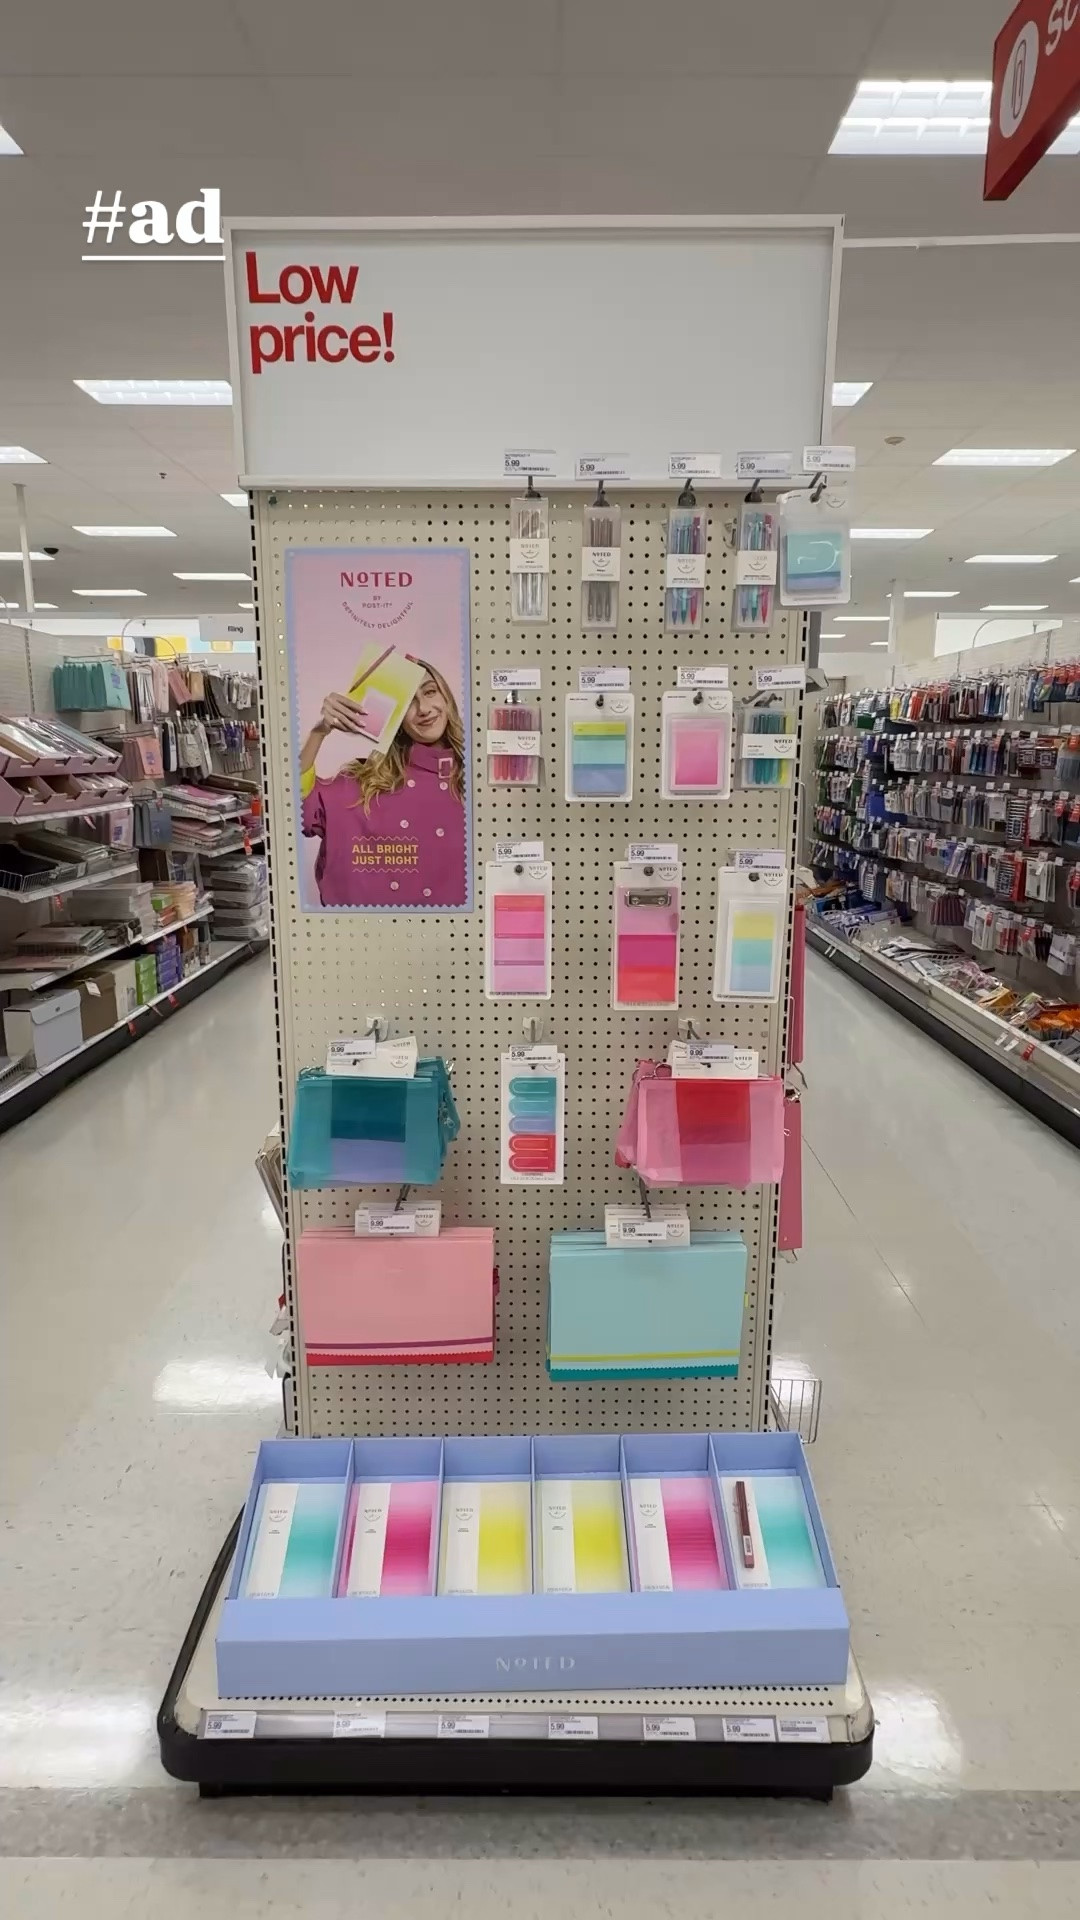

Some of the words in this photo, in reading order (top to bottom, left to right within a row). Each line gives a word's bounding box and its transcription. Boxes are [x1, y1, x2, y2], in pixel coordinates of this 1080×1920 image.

[246, 251, 360, 305] Low
[250, 311, 395, 375] price!
[340, 572, 413, 588] NOTED
[342, 601, 375, 629] DEFINITELY
[377, 601, 414, 629] DELIGHTFUL
[758, 675, 772, 683] 5.99
[352, 844, 373, 853] ALL
[376, 844, 419, 853] BRIGHT
[352, 856, 381, 865] JUST
[384, 856, 419, 865] RIGHT
[207, 1721, 222, 1730] 5.99
[441, 1721, 456, 1729] 5.99
[727, 1725, 741, 1733] 5.99
